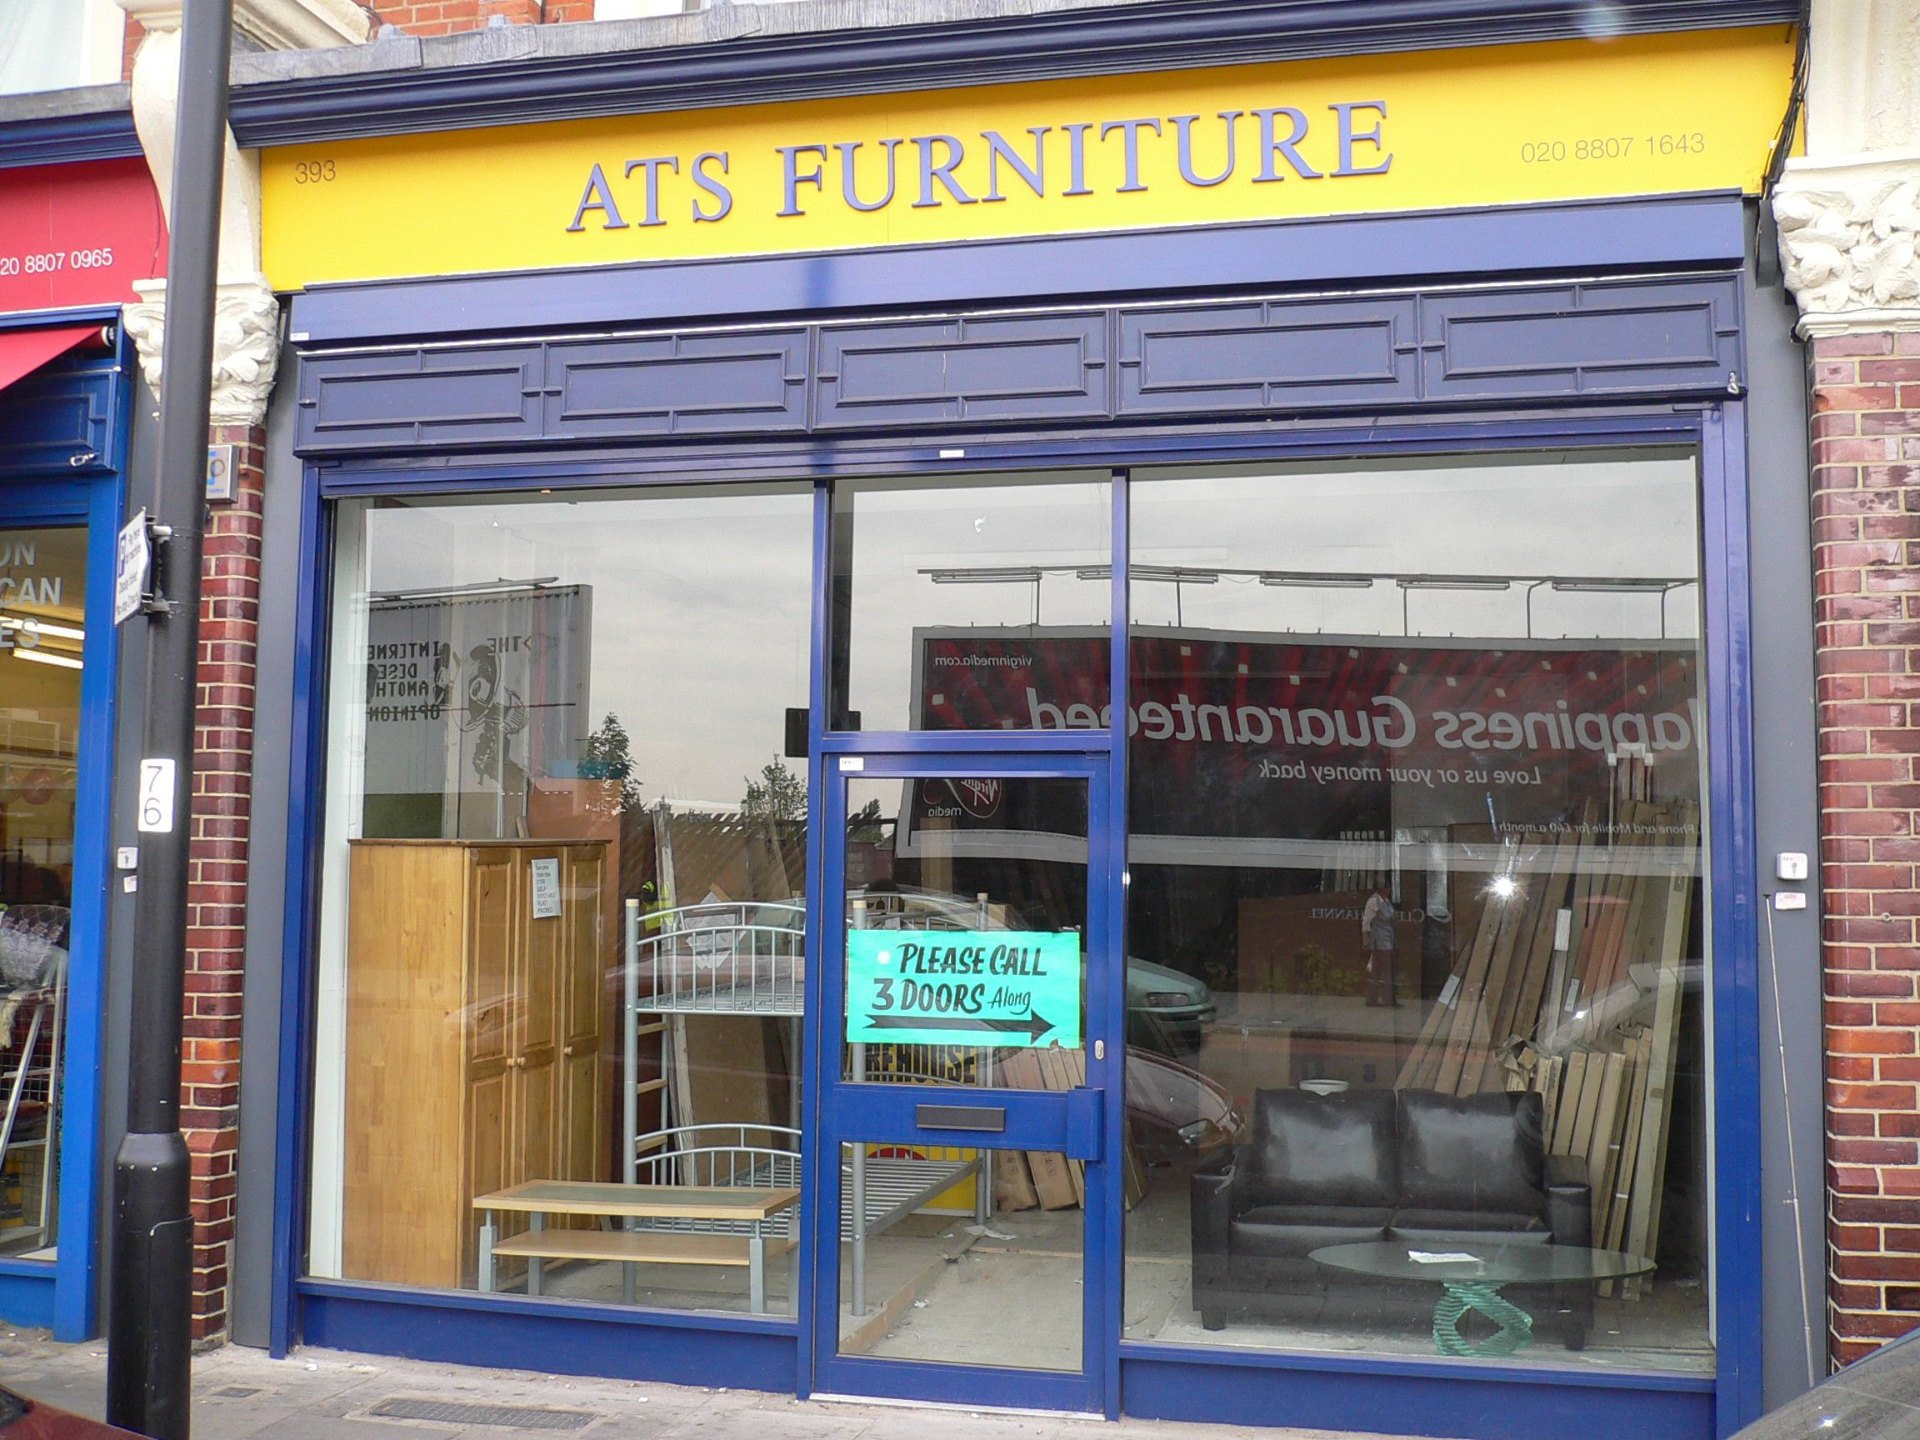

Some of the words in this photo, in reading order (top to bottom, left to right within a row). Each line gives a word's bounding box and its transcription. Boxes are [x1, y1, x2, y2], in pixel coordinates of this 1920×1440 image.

[1521, 142, 1566, 163] 020
[1575, 137, 1634, 160] 8807
[1645, 132, 1705, 156] 1643
[295, 160, 336, 184] 393
[566, 151, 732, 232] ATS
[776, 100, 1393, 217] FURNITURE
[24, 252, 66, 273] 8807
[70, 248, 113, 269] 0965
[897, 943, 987, 975] PLEASE
[989, 944, 1047, 976] CALL
[871, 978, 894, 1010] 3
[900, 978, 986, 1014] DOORS
[987, 986, 1032, 1015] Along
